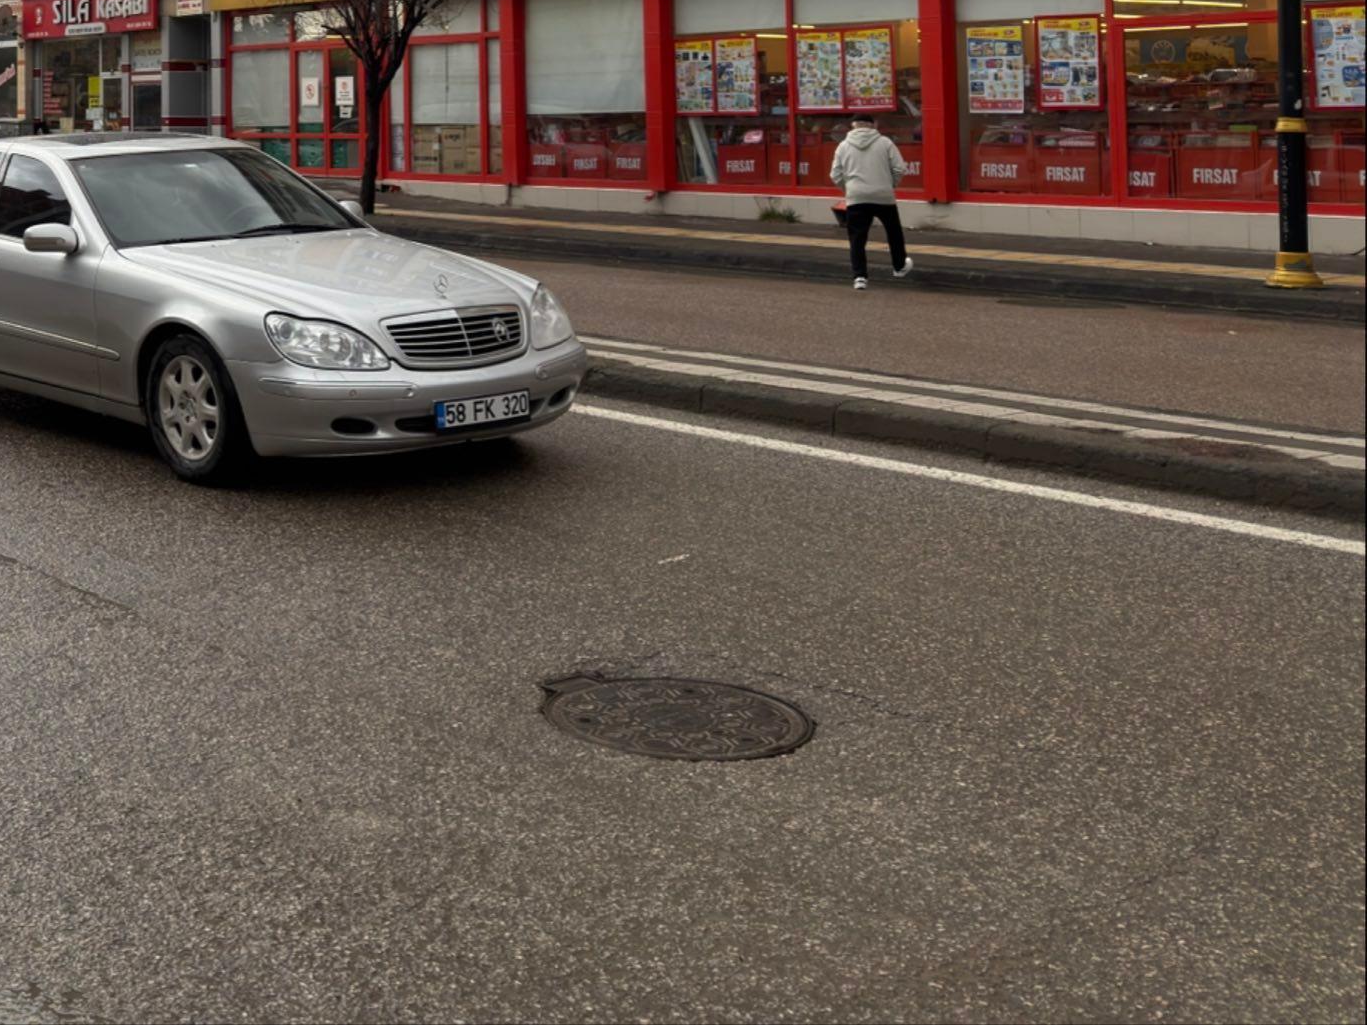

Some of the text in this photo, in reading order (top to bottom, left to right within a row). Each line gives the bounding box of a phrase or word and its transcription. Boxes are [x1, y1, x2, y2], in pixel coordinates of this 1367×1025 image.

[726, 159, 755, 173] FIRSAT
[981, 163, 1018, 179] FIRSAT
[1046, 166, 1086, 182] FIRSAT
[1192, 168, 1238, 184] FIRSAT
[446, 393, 528, 424] 58 FK 320
